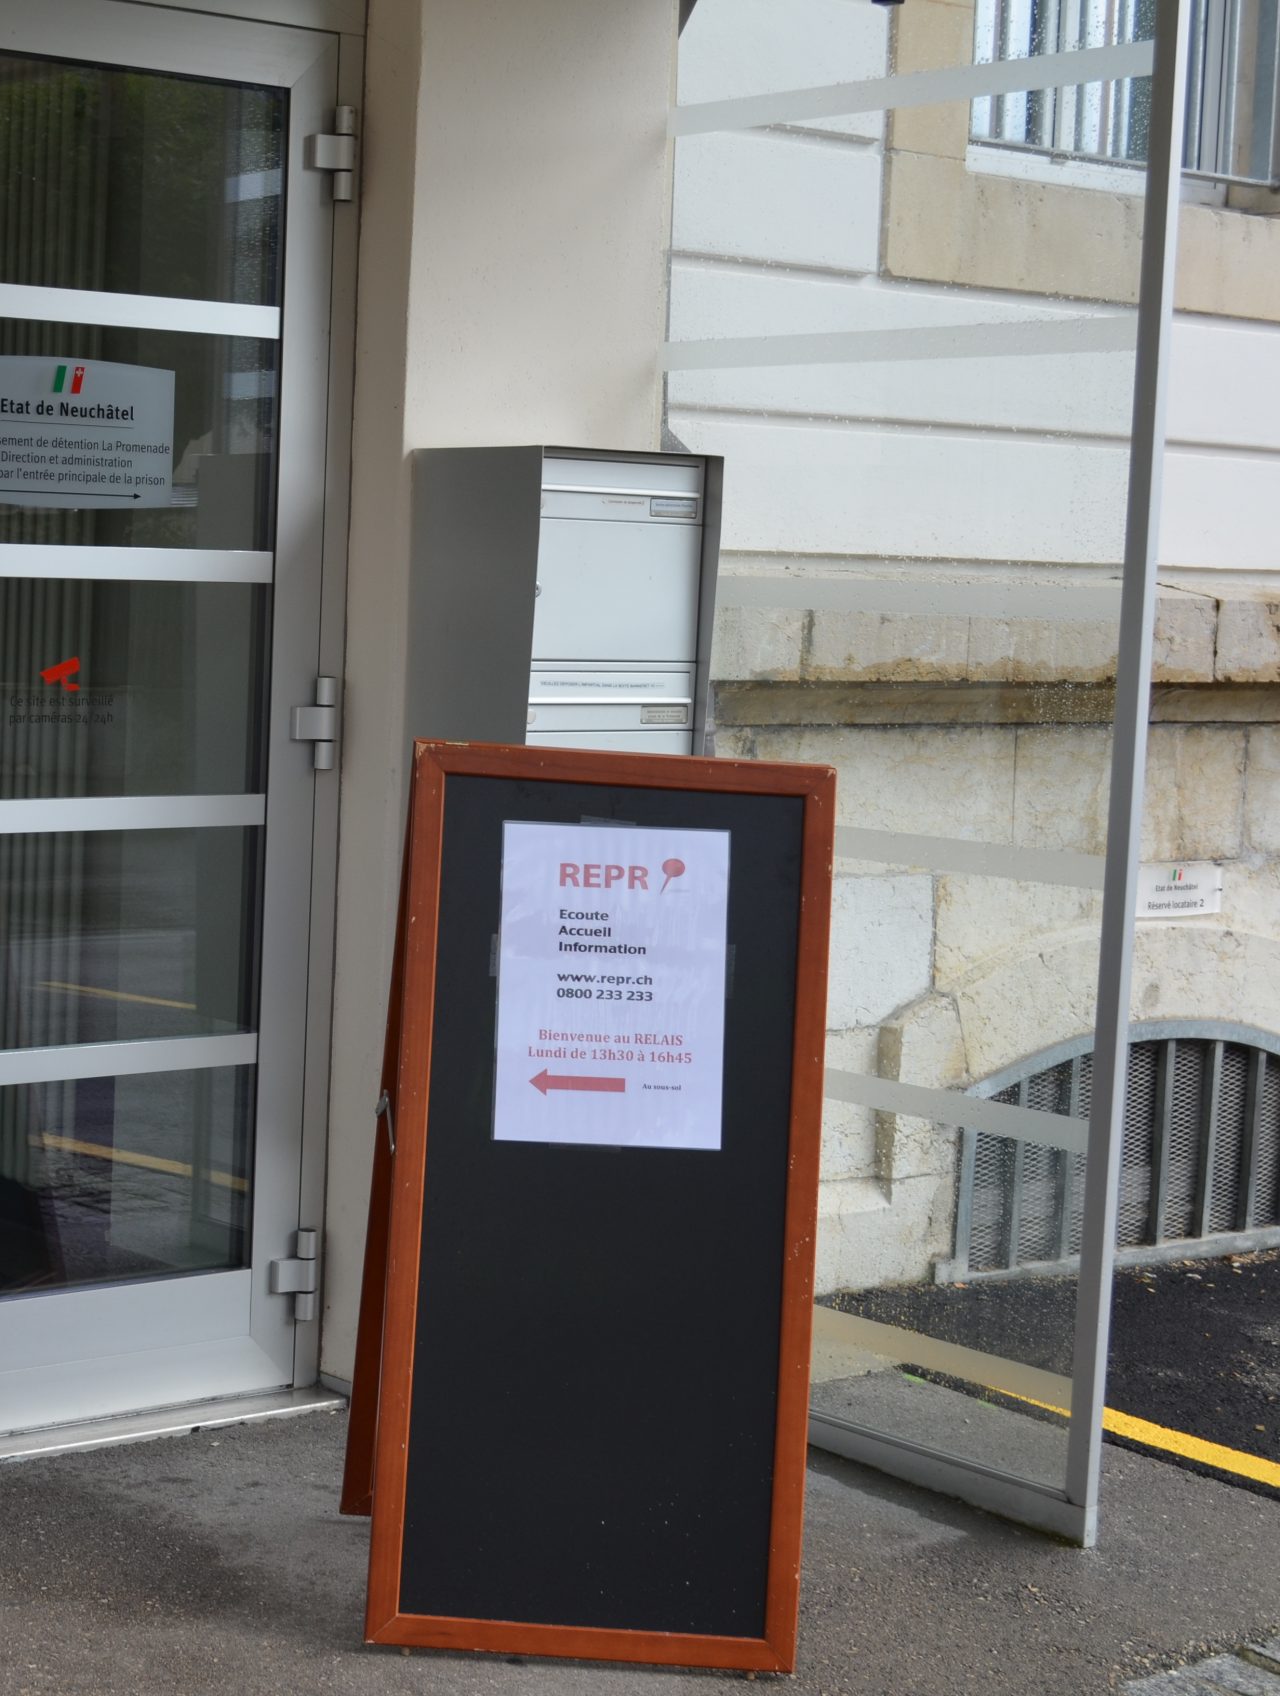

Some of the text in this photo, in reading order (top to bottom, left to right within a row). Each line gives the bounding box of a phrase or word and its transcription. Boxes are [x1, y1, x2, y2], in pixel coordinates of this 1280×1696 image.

[0, 398, 135, 421] Etat de Neuchâtel
[36, 435, 48, 448] de
[51, 436, 99, 451] détention
[102, 440, 113, 451] La
[116, 440, 170, 454] Promenade
[1, 451, 133, 468] Direction et administration
[16, 467, 55, 481] l'entrée
[58, 469, 106, 484] principale
[109, 471, 121, 484] de
[124, 472, 132, 484] la
[135, 474, 165, 488] prison
[9, 714, 26, 727] par
[558, 862, 649, 890] REPR
[1200, 898, 1205, 908] 2
[559, 909, 609, 921] Ecoute
[558, 925, 612, 938] Accueil
[558, 941, 647, 955] Information
[557, 972, 653, 987] www.repr.ch
[556, 988, 653, 1002] 0800 233 233
[538, 1028, 683, 1047] Bienvenue au RELAIS
[527, 1046, 692, 1064] Lundi de 13h30 à 16h45
[642, 1082, 682, 1092] Au sous-sol
